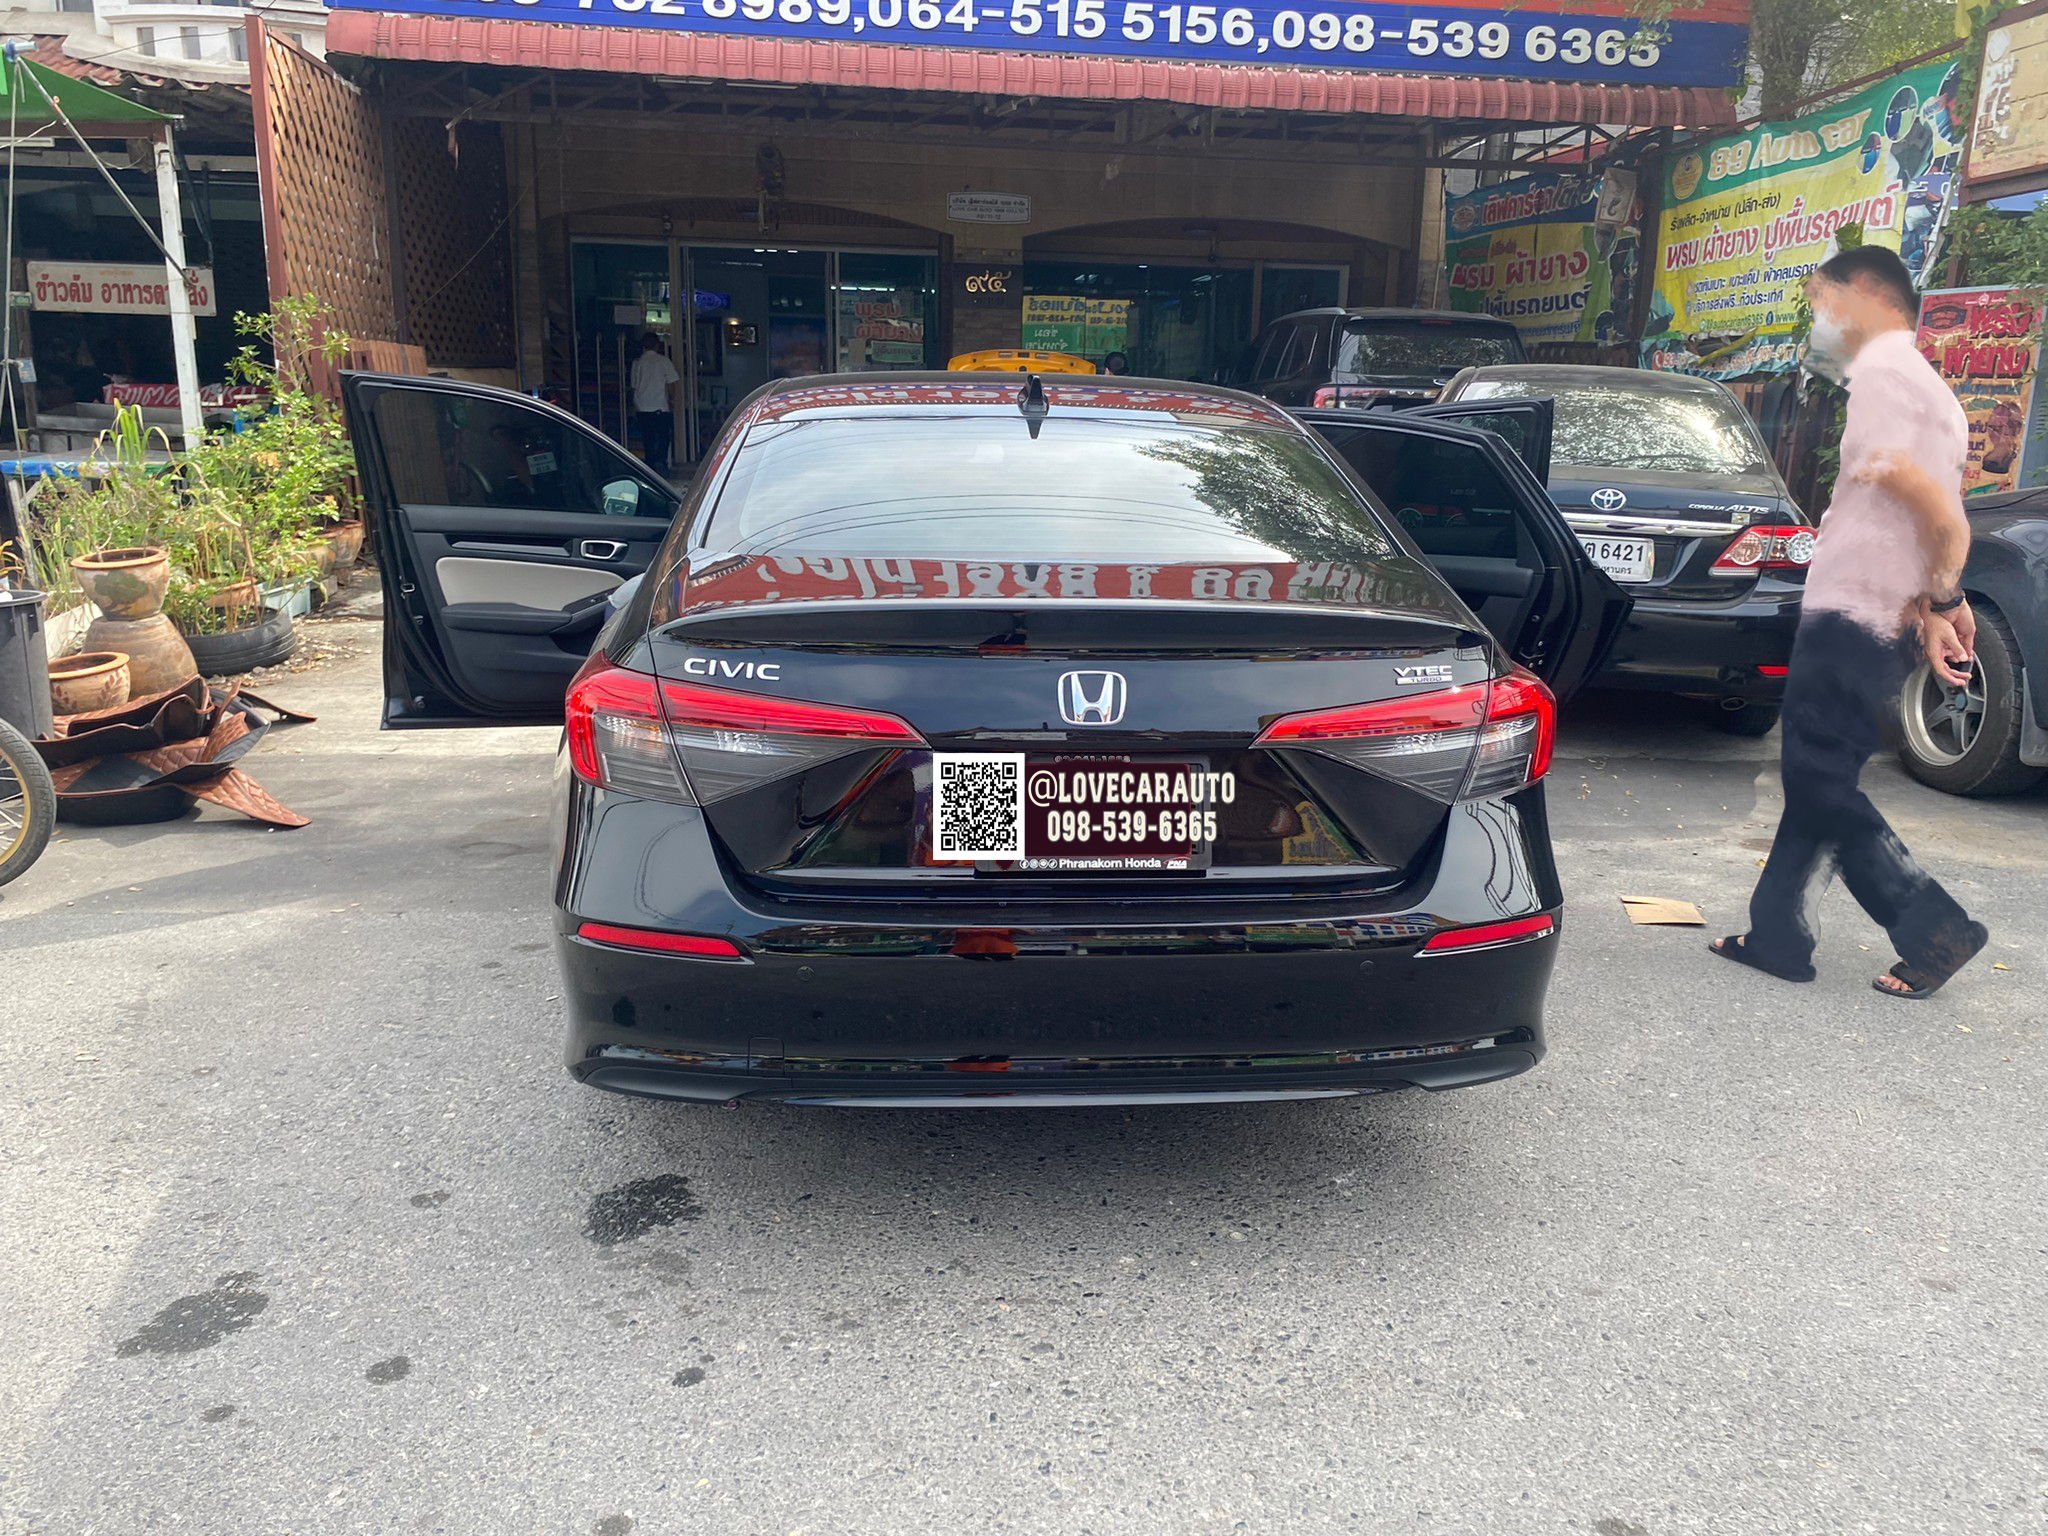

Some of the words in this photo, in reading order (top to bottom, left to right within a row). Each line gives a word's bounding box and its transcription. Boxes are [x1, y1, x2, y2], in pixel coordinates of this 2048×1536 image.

[1120, 3, 1510, 61] 5156,098-539
[1524, 25, 1660, 69] 6365
[1707, 140, 1752, 181] 89
[1666, 239, 1700, 269] พรม
[1702, 224, 1760, 262] ผ้ายาง
[1505, 250, 1590, 287] ผ้ายาง
[35, 273, 93, 304] ข้าวต้ม
[101, 269, 208, 306] อาหารตสั่ง
[1688, 503, 1726, 511] COROLLA
[1725, 504, 1770, 515] ALTIS
[1600, 543, 1644, 561] 6421
[683, 657, 781, 681] CIVIC
[1393, 665, 1453, 677] VTEC
[1058, 857, 1123, 869] Phranakorn
[1125, 857, 1162, 868] Honda
